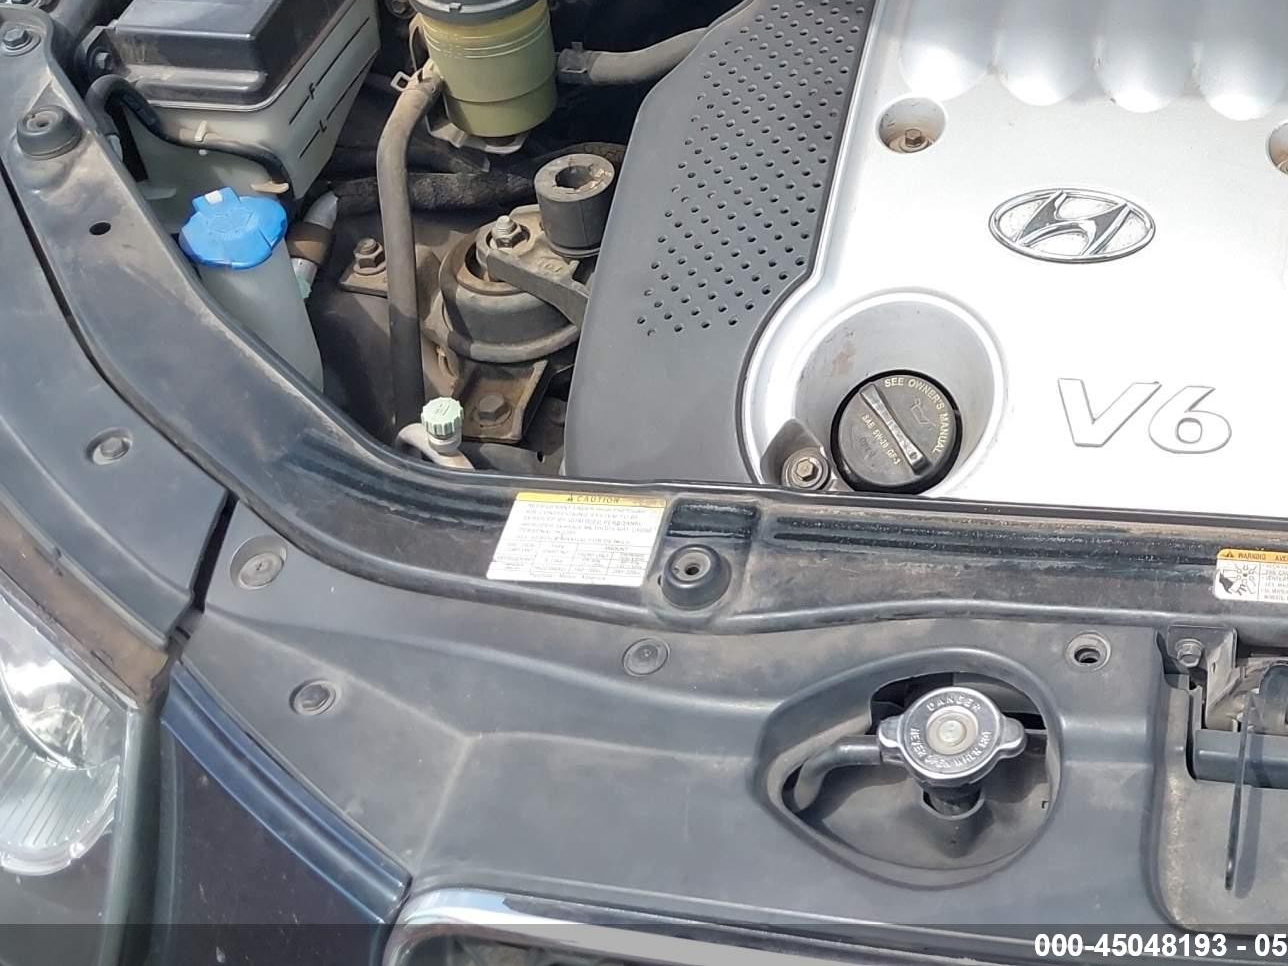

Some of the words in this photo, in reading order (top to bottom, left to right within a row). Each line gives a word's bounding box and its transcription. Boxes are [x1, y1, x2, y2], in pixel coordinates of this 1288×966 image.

[862, 414, 876, 429] SAE
[884, 377, 905, 388] SEE
[908, 378, 945, 410] OWNER'S
[932, 413, 950, 453] MANUAL
[1056, 377, 1233, 455] V6
[576, 494, 620, 504] CAUTION
[1237, 553, 1267, 561] WARNING
[926, 696, 982, 712] DANGER
